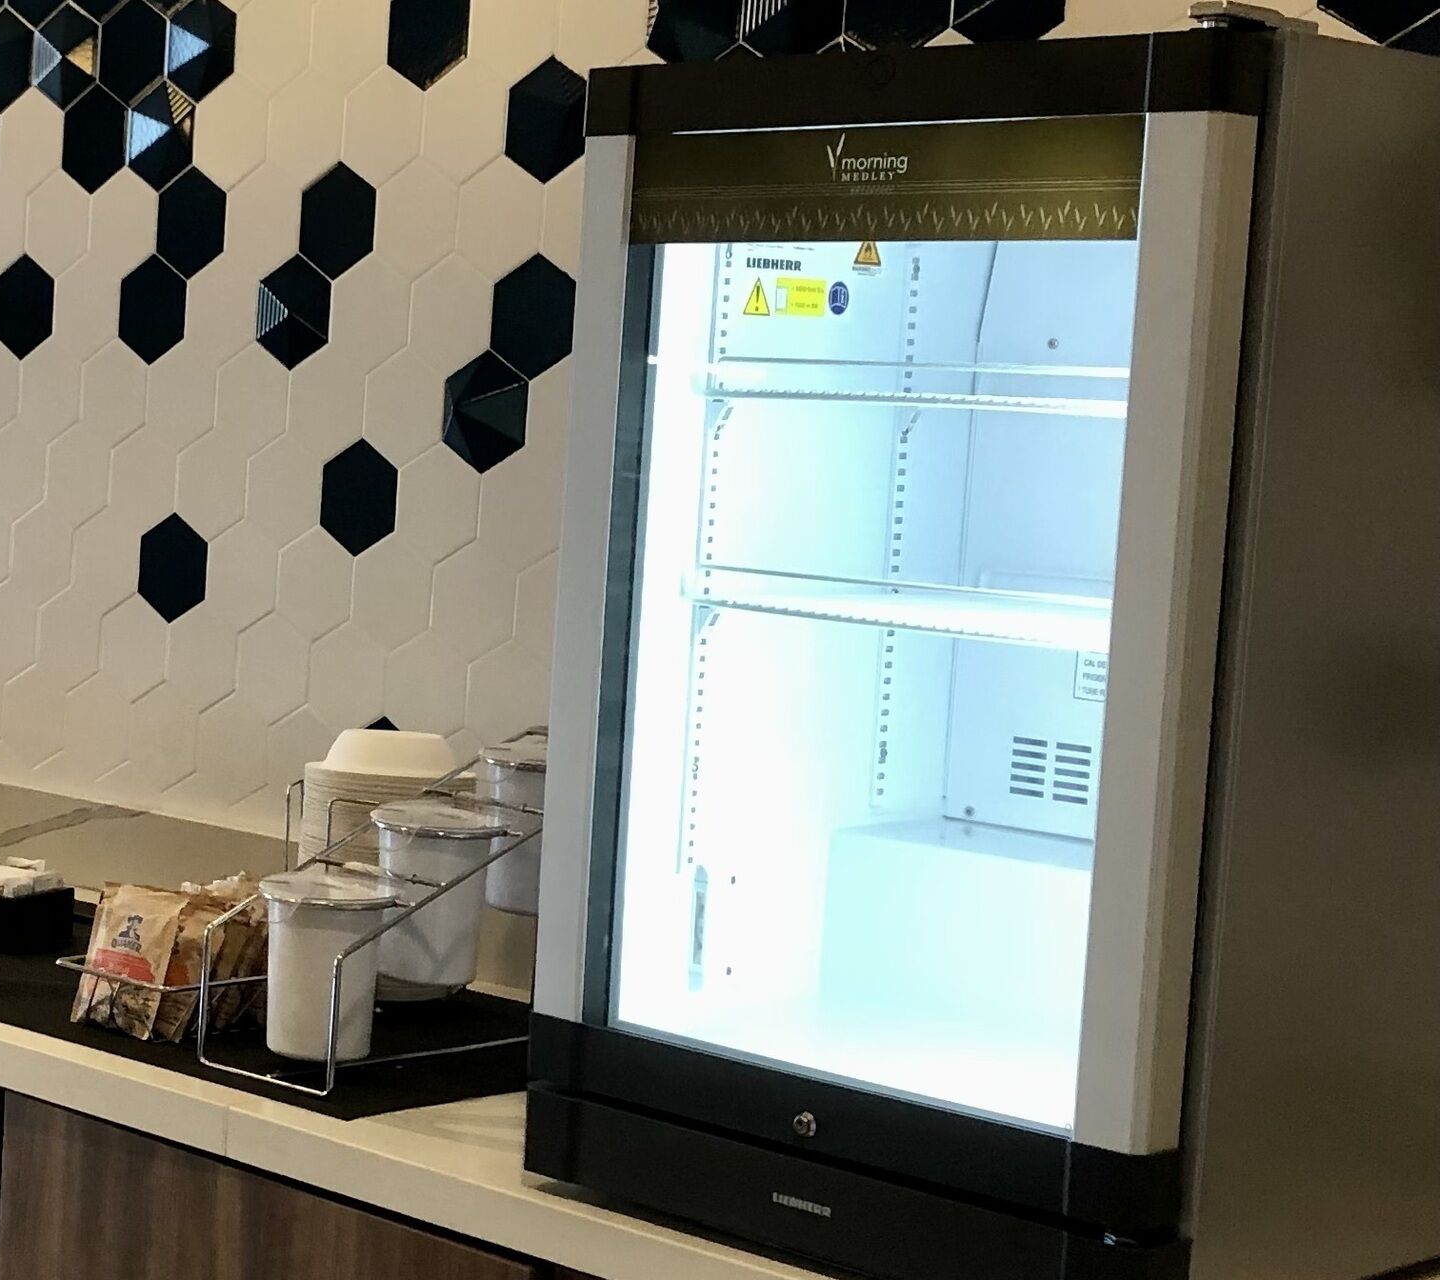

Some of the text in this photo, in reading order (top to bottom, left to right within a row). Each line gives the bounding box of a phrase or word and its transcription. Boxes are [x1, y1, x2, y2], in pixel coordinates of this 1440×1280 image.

[841, 151, 908, 174] morning
[841, 171, 895, 182] MEDLEY
[746, 257, 802, 271] LIEBHERR
